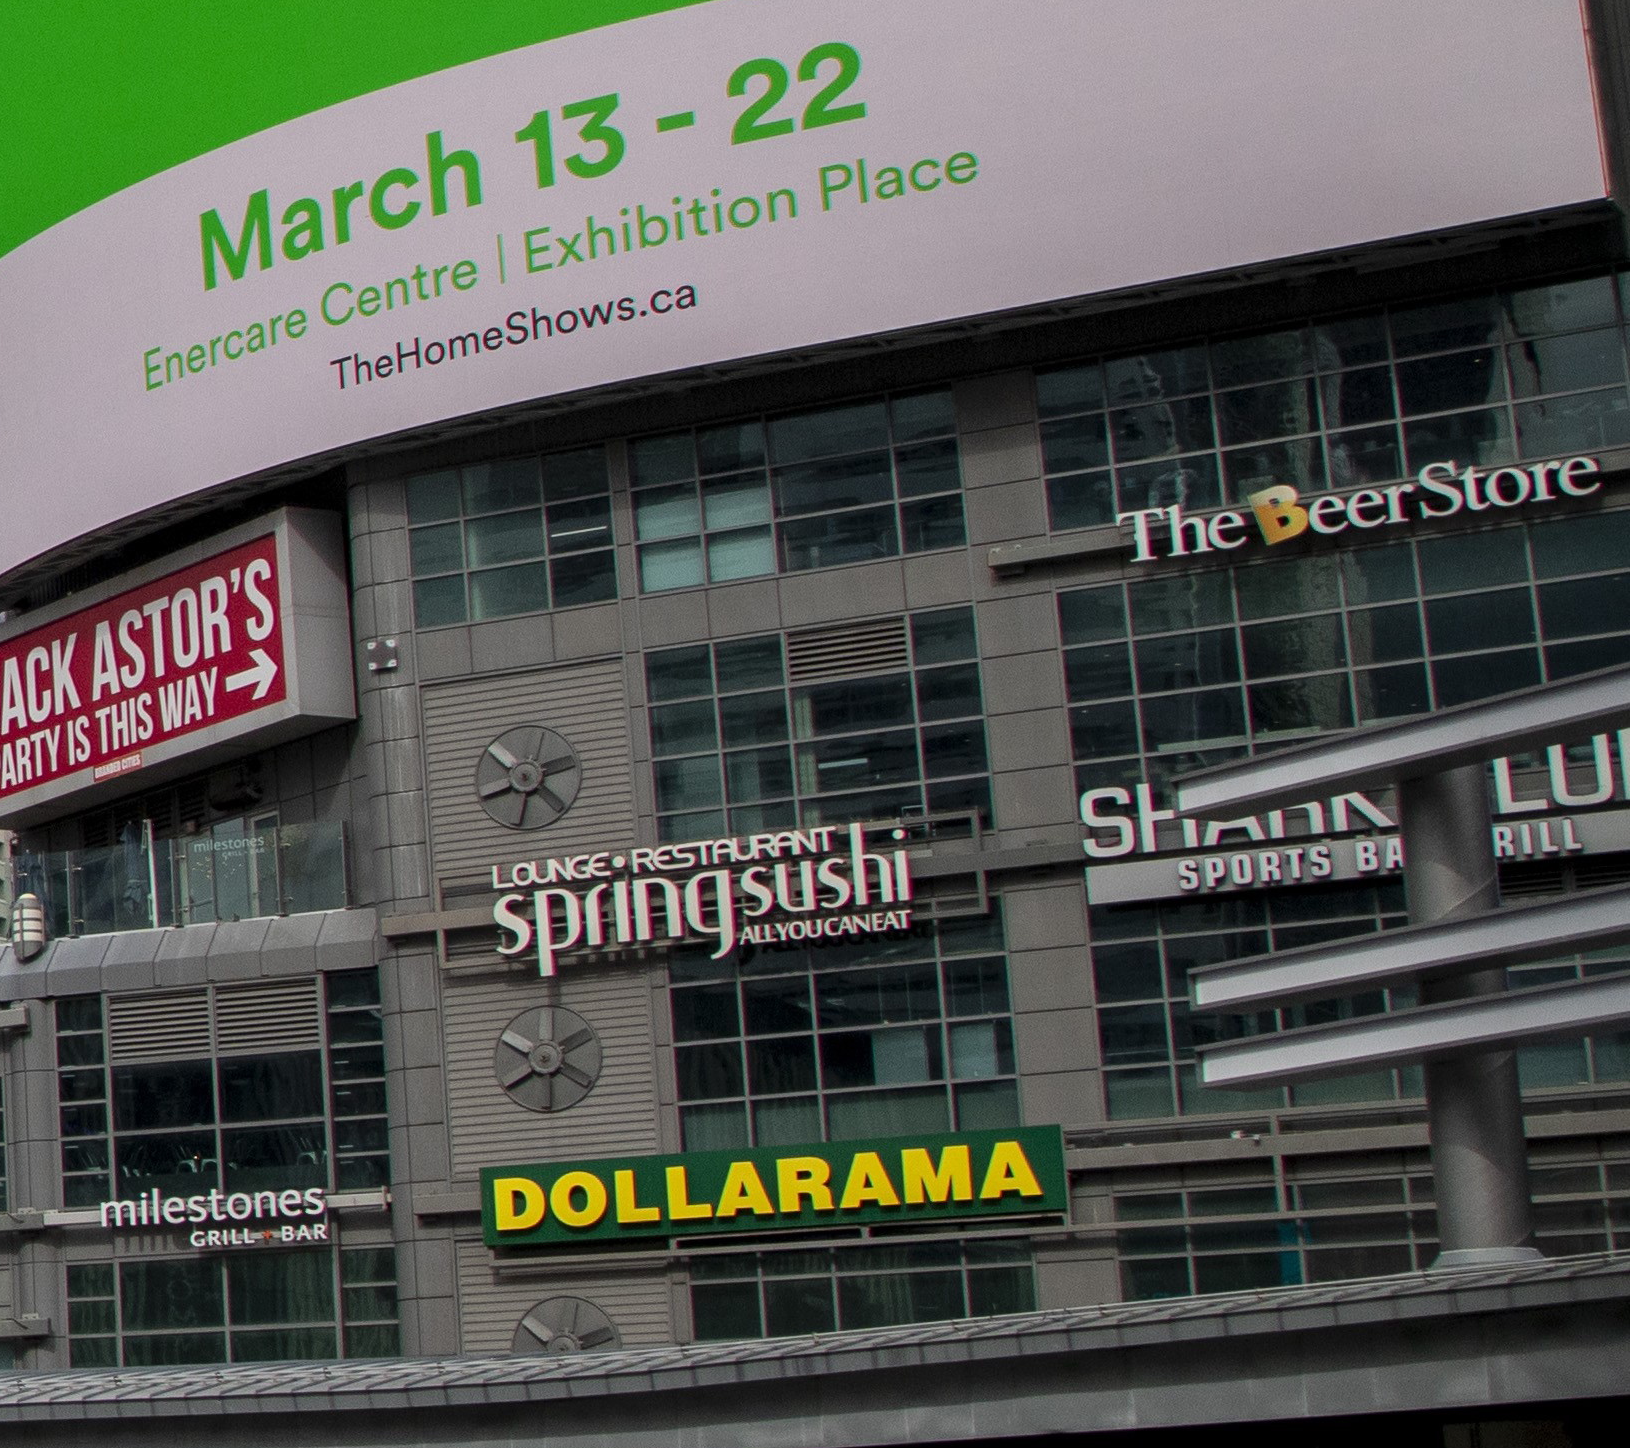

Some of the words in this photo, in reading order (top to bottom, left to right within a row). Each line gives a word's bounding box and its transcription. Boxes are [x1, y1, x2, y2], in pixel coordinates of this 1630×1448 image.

[197, 130, 487, 293] March
[512, 92, 628, 194] 13
[725, 41, 868, 149] 22
[142, 305, 311, 393] Enercare
[319, 252, 480, 331] Centre
[522, 171, 800, 278] Exhibition
[817, 148, 981, 219] Place
[329, 281, 699, 394] TheHomeShows.ca
[1115, 504, 1248, 562] The
[1249, 481, 1419, 547] Beer
[1418, 456, 1603, 520] Store
[91, 557, 274, 704] ASTOR'S
[65, 714, 92, 766] IS
[95, 694, 153, 756] THIS
[158, 666, 219, 733] WAY
[193, 835, 265, 854] milestones
[491, 851, 611, 891] LOUNGE
[631, 826, 838, 875] RESTAURANT
[1177, 845, 1333, 893] SPORTS
[1356, 835, 1404, 874] BA
[1494, 818, 1585, 858] RILL
[99, 1186, 327, 1229] milestones
[189, 1226, 256, 1249] GRILL
[280, 1221, 330, 1243] BAR
[492, 1141, 1043, 1233] DOLLARAMA
